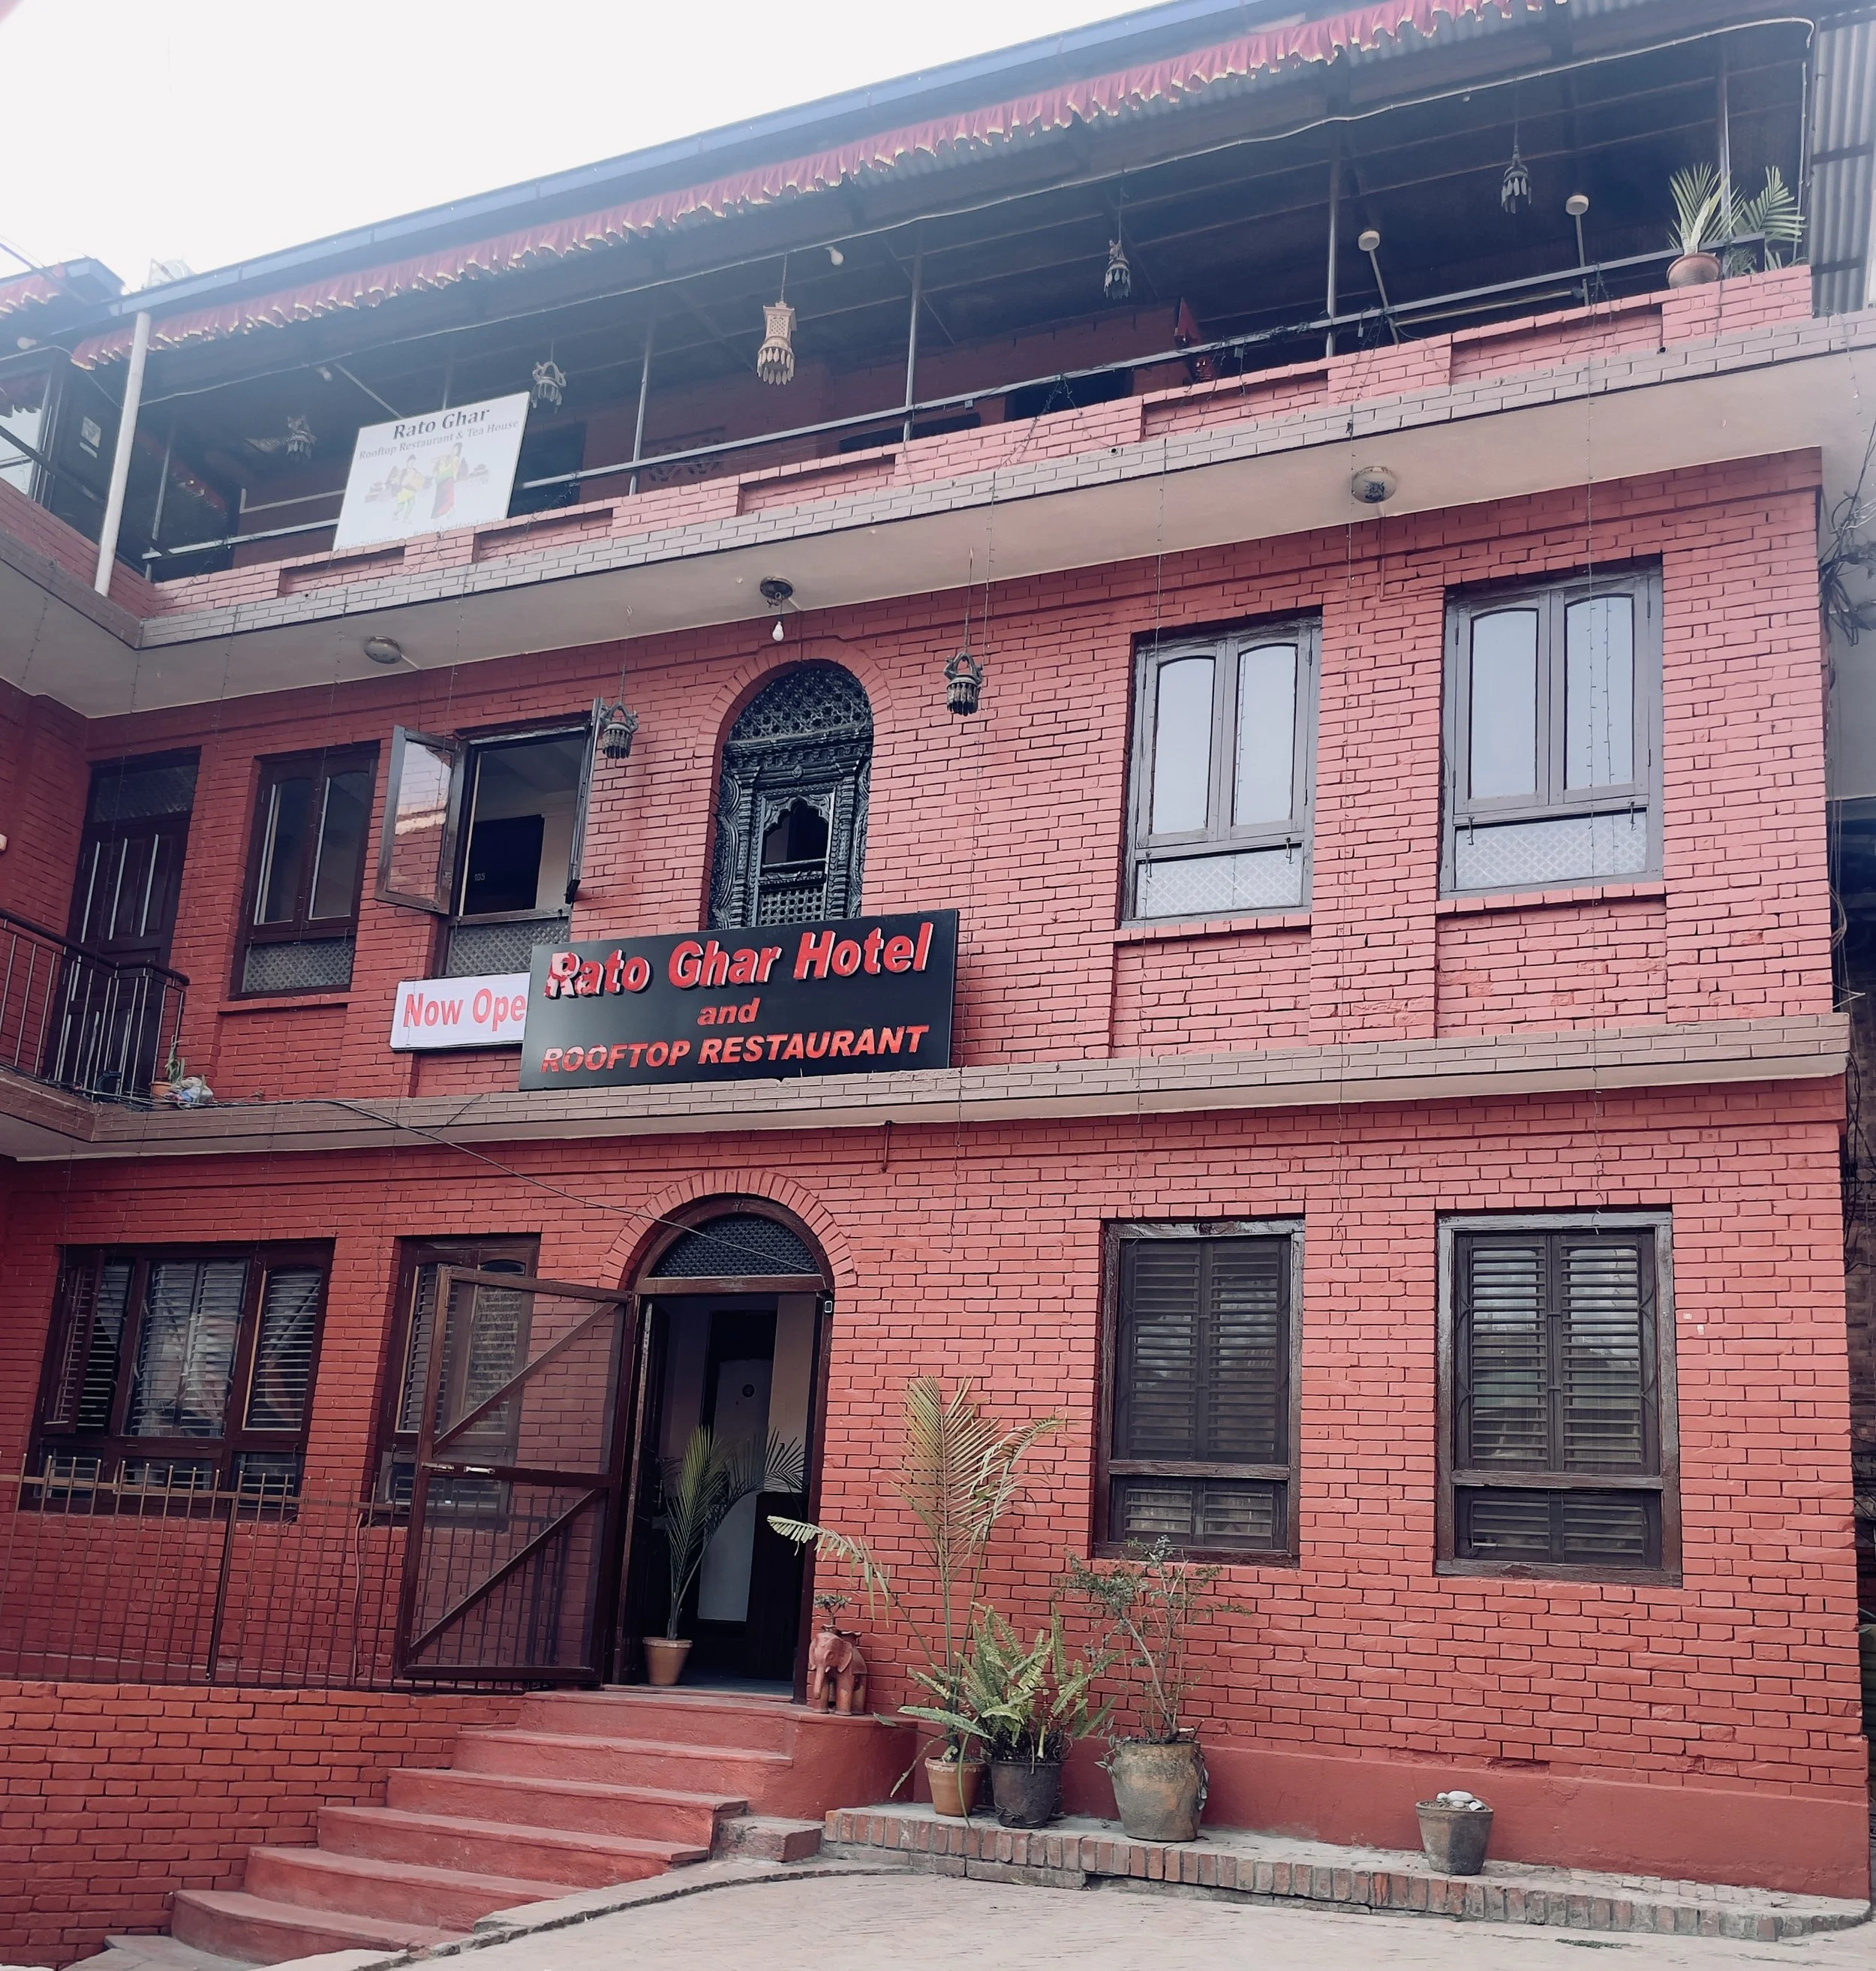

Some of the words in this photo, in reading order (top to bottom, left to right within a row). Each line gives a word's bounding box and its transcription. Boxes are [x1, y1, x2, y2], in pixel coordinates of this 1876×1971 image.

[359, 445, 397, 460] Rooftop
[399, 433, 454, 452] Restaurant
[455, 430, 464, 440] &
[467, 427, 484, 438] Tea
[487, 420, 519, 435] House
[393, 420, 436, 440] Rato
[442, 409, 490, 430] Ghar
[544, 949, 651, 998] Rato
[669, 940, 782, 988] Ghar
[793, 922, 933, 980] Hotel
[403, 993, 464, 1028] Now
[697, 997, 761, 1026] and
[540, 1040, 691, 1073] ROOFTOP
[697, 1025, 929, 1064] RESTAURANT
